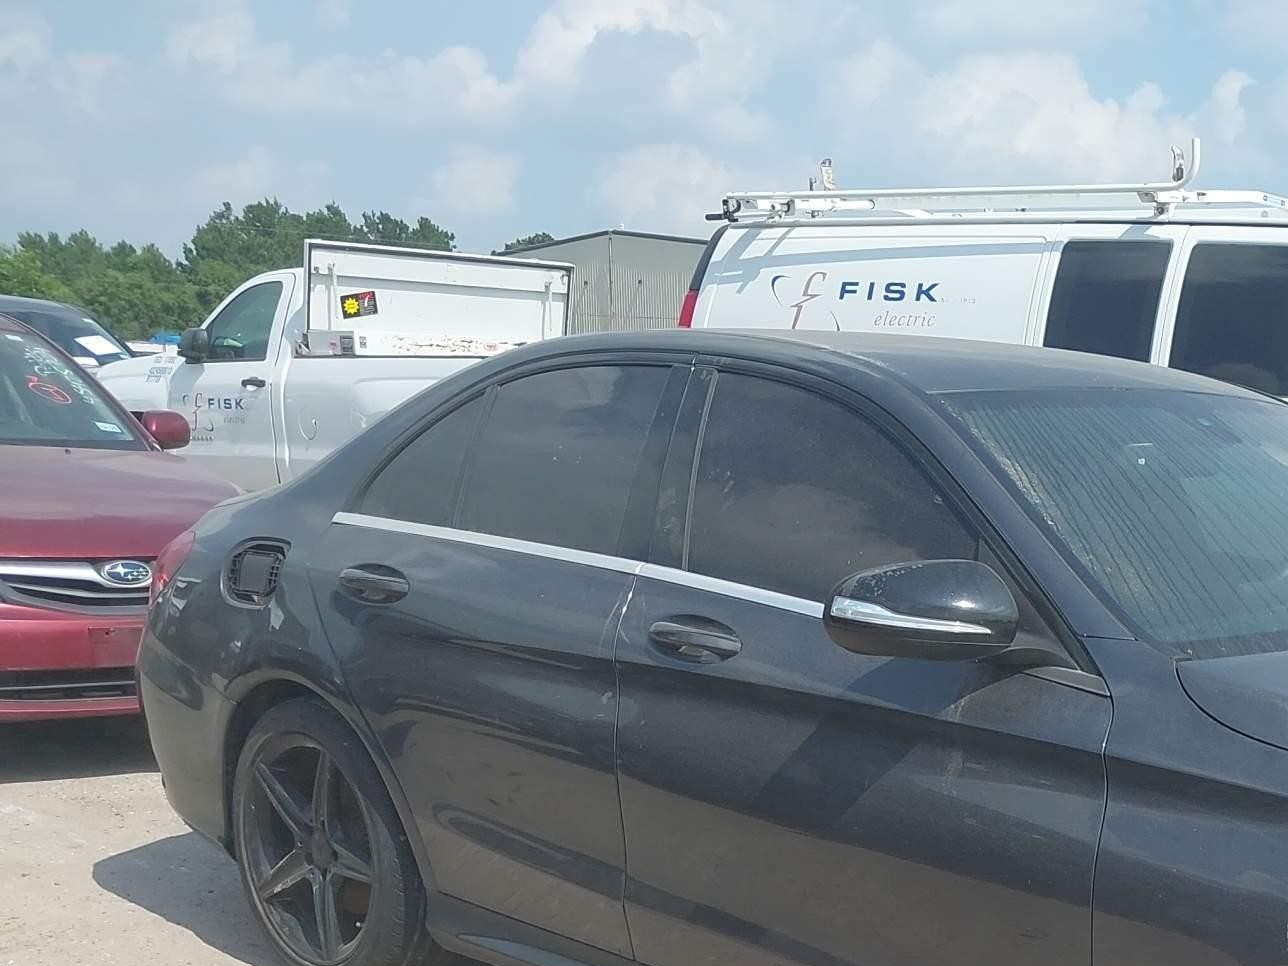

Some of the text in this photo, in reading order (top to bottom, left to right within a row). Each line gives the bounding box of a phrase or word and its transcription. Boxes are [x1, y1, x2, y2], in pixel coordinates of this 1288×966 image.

[838, 281, 941, 302] FISK
[874, 310, 936, 327] electric
[207, 398, 244, 410] FISK
